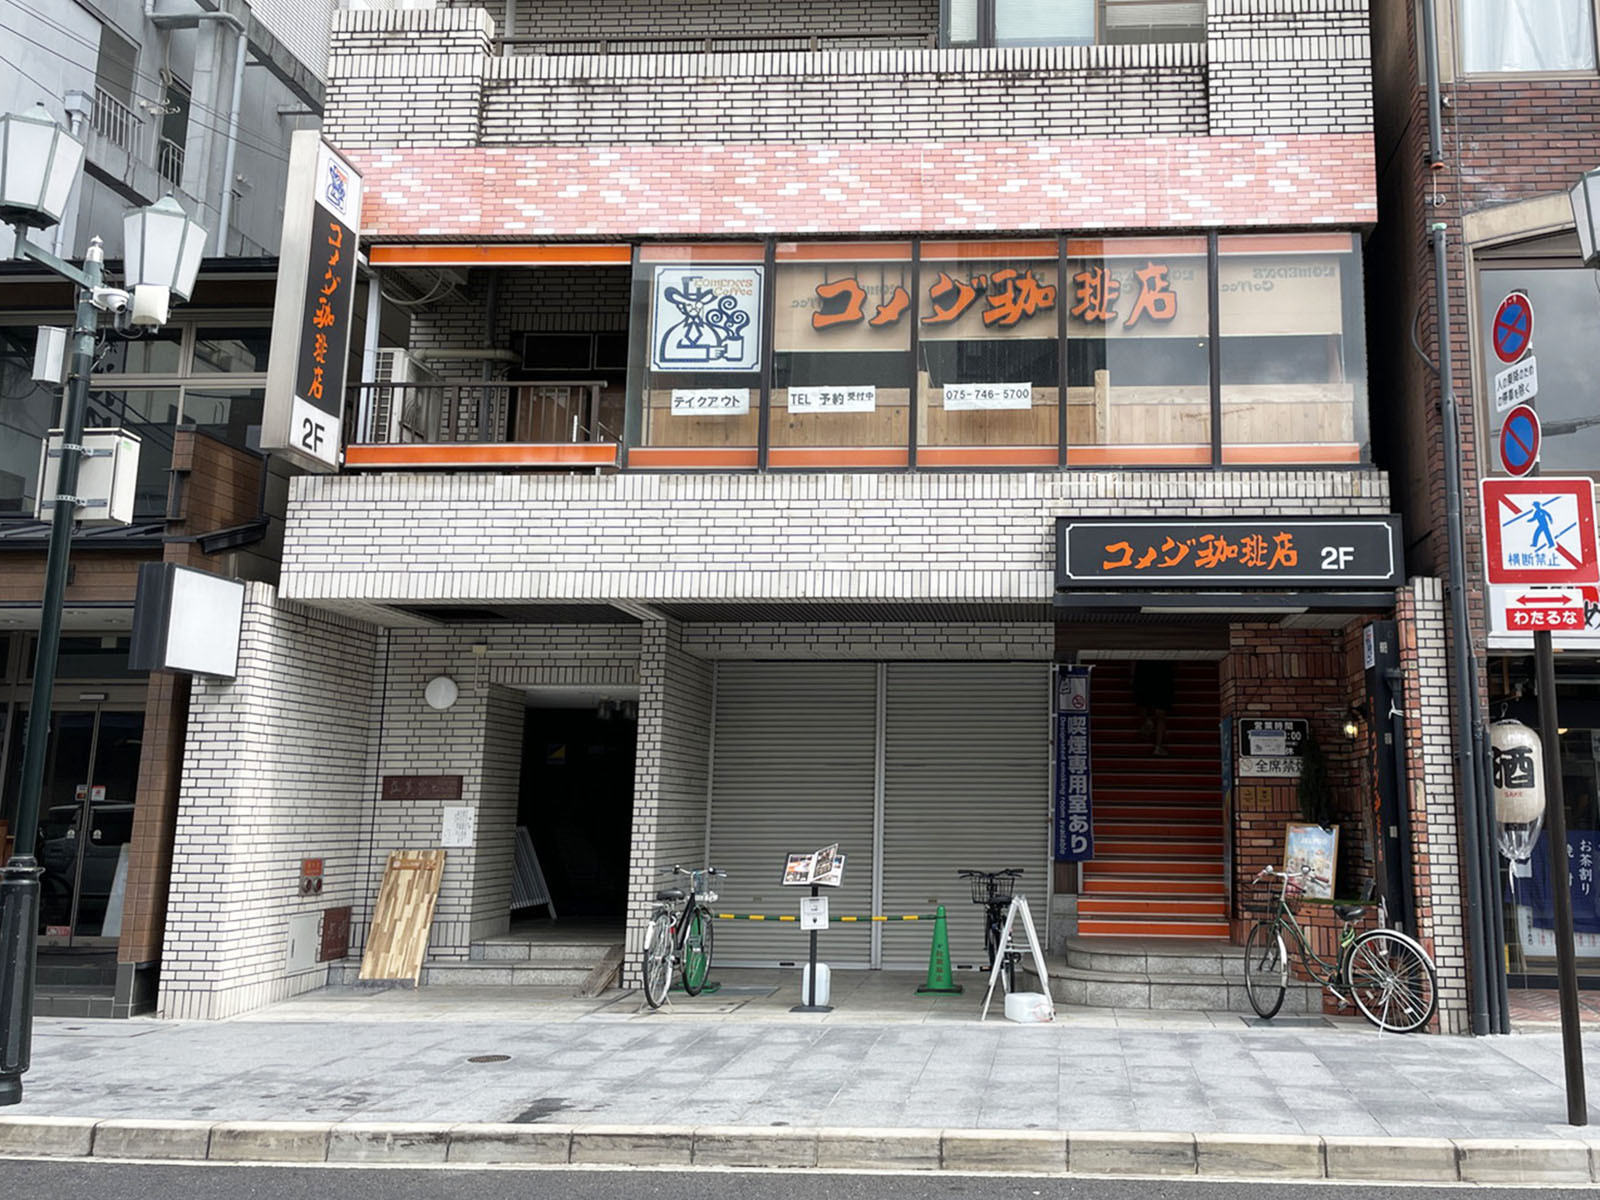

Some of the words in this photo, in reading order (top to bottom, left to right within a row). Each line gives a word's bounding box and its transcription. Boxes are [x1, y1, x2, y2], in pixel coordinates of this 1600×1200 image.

[308, 222, 343, 399] コメダ珈琲店
[674, 395, 741, 408] テイクアウト
[790, 393, 812, 406] TEL
[819, 393, 844, 406] 予約
[847, 391, 874, 402] 受付中
[945, 388, 1030, 402] 075-746-5700
[302, 417, 325, 453] 2F
[1103, 532, 1298, 570] コメダ珈琲店
[1320, 546, 1354, 570] 2F
[1507, 552, 1561, 567] 横断禁止
[1513, 610, 1578, 625] わたるな
[1067, 715, 1089, 855] 喫煙専用室あり
[1491, 746, 1536, 789] 酒
[1578, 839, 1593, 896] お茶割り
